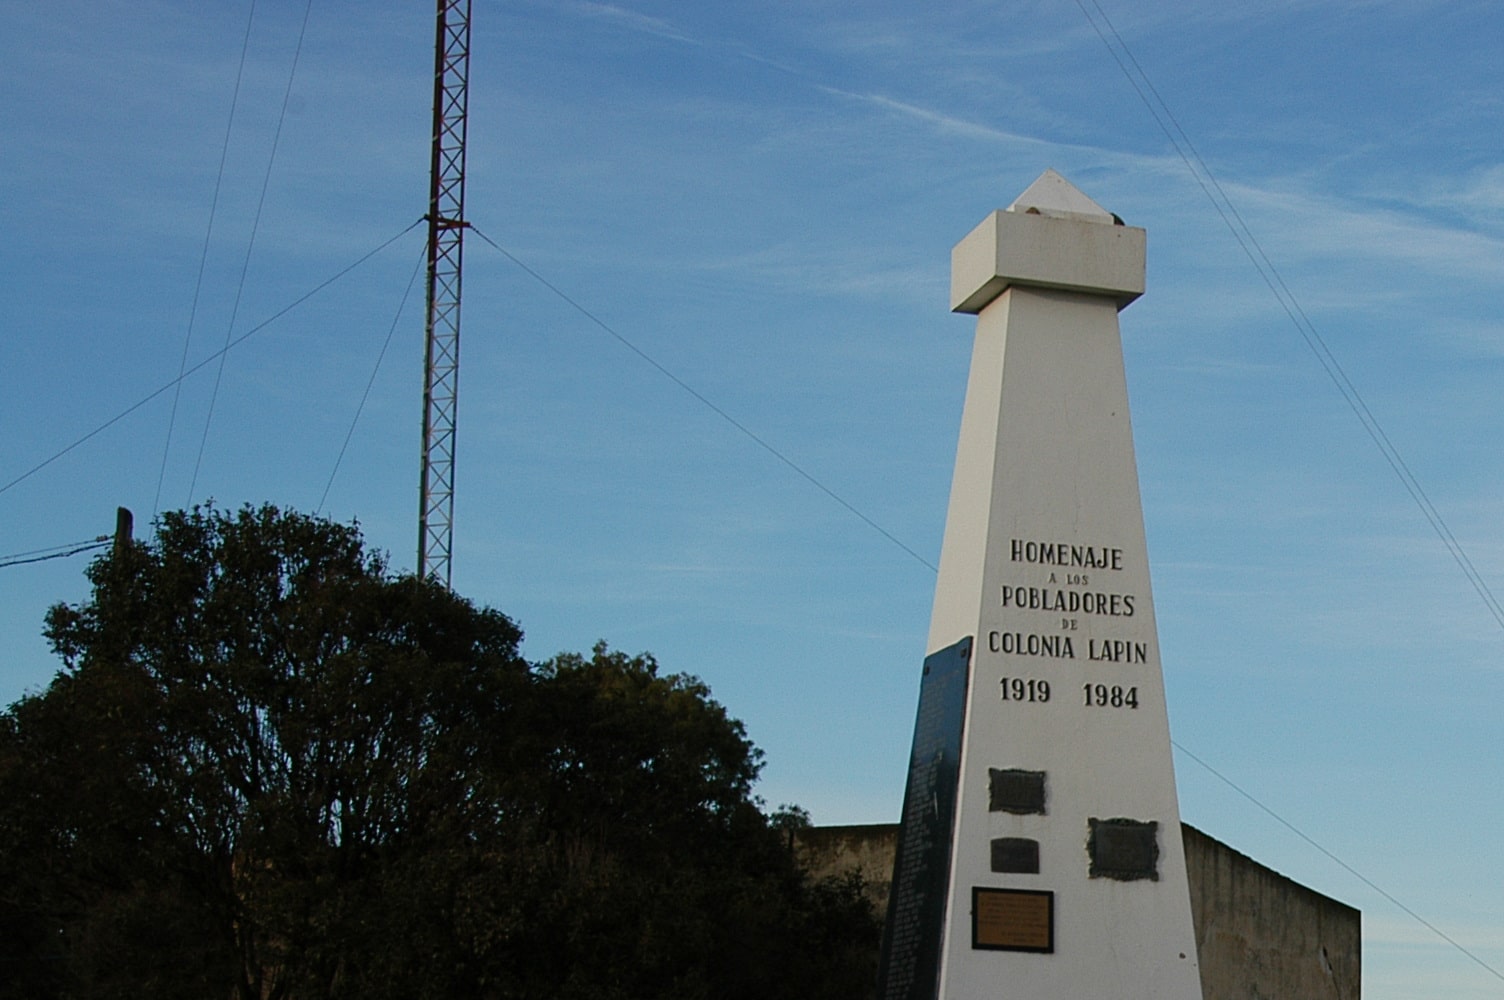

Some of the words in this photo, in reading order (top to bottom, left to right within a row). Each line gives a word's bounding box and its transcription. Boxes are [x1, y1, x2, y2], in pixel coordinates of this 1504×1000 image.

[1011, 539, 1123, 570] HOMENAJE
[1048, 573, 1057, 584] A
[1066, 574, 1089, 586] LOS
[1001, 586, 1135, 617] POBLADORES
[1062, 619, 1078, 631] DE
[989, 631, 1075, 659] COLONIA
[1088, 639, 1147, 664] LAPIN
[1000, 677, 1051, 703] 1919
[1083, 683, 1139, 709] 1984
